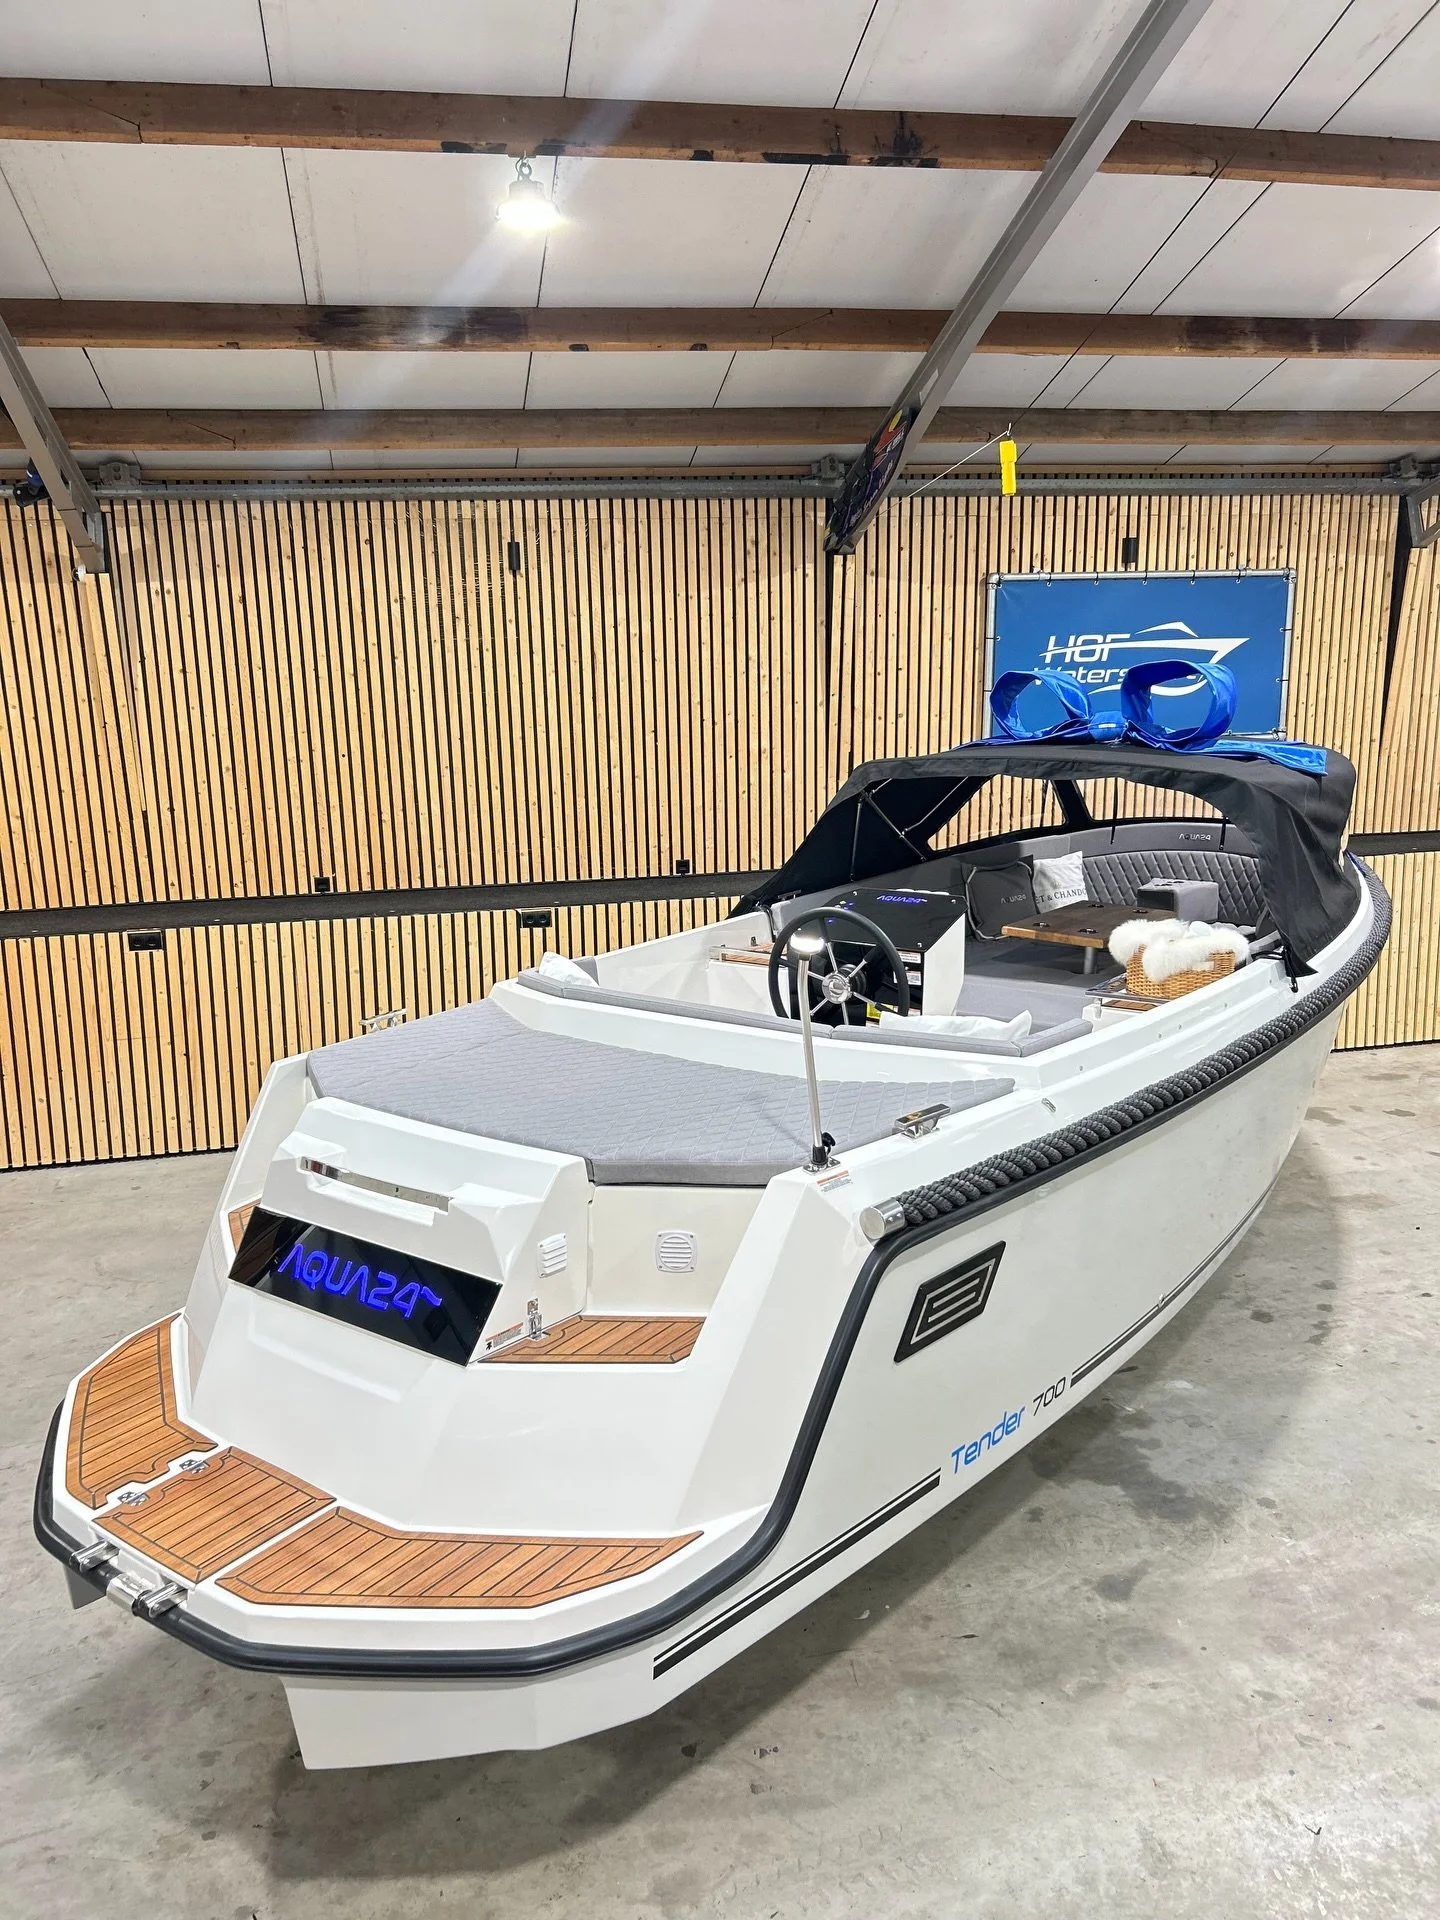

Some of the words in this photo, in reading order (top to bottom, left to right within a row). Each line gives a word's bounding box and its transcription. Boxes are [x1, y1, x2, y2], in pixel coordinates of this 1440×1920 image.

[1044, 633, 1131, 664] HOF
[277, 1243, 421, 1320] AQUA24
[951, 1406, 1025, 1474] Tender
[1033, 1376, 1067, 1416] 700
